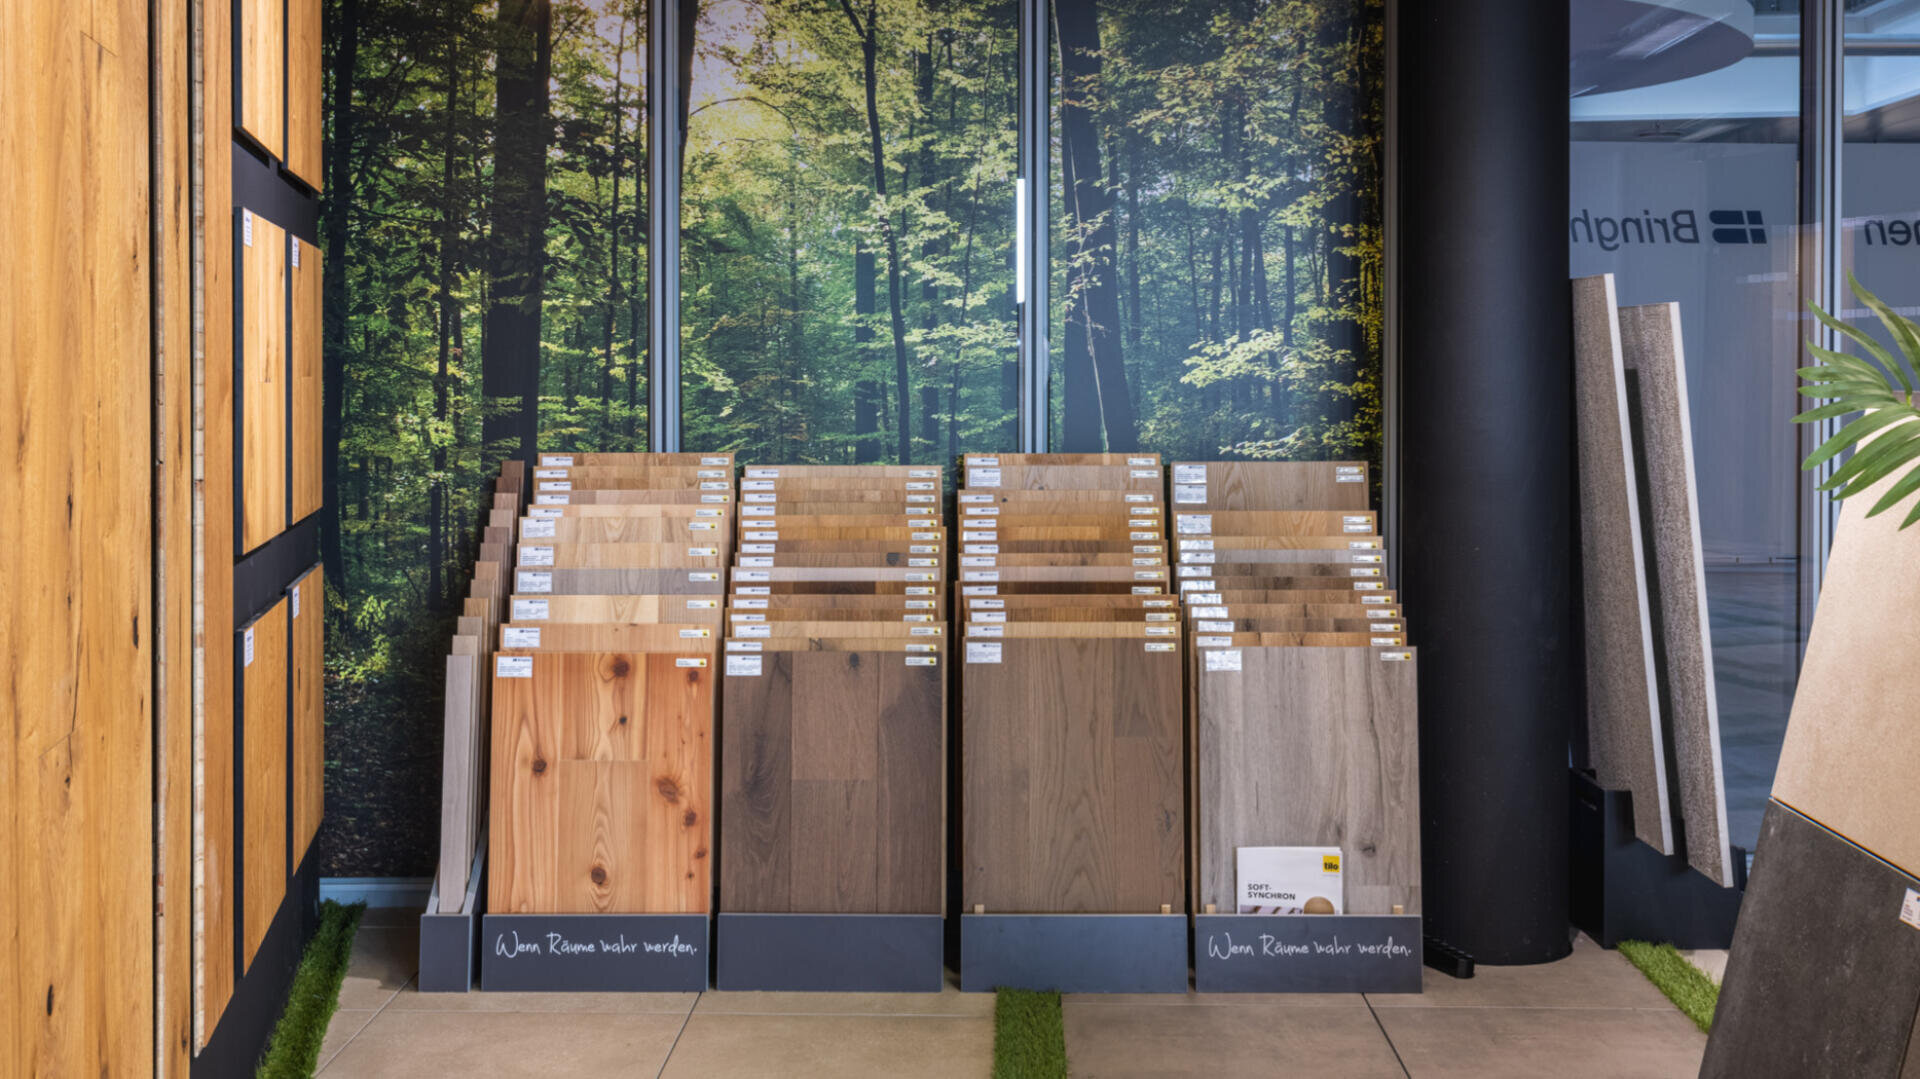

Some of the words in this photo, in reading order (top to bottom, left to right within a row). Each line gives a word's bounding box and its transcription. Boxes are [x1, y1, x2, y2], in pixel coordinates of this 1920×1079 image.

[1324, 862, 1338, 870] tilo
[1247, 883, 1272, 891] SOFT-
[1247, 891, 1296, 900] SYNCHRON
[495, 930, 541, 958] Wenn
[546, 931, 595, 955] Räume
[600, 934, 637, 954] wahr
[643, 934, 697, 957] werden.
[1208, 932, 1254, 960] Wenn
[1259, 933, 1309, 957] Räume
[1313, 935, 1352, 955] wahr
[1357, 936, 1412, 959] werden.
